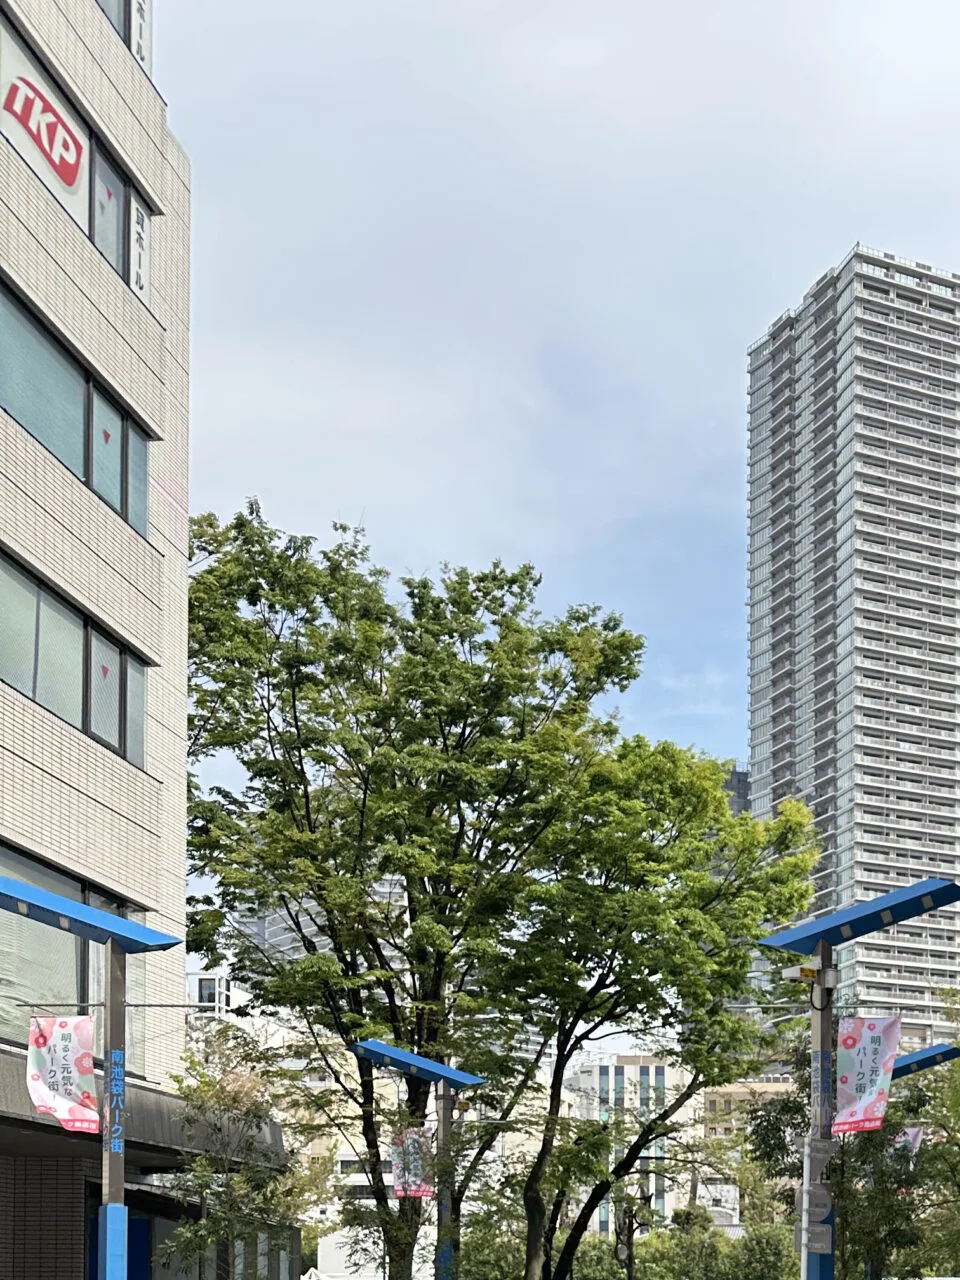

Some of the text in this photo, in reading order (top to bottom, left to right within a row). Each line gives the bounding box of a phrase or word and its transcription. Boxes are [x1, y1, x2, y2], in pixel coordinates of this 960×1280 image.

[11, 79, 77, 167] TKP
[60, 1032, 73, 1097] 明るく元気な
[111, 1049, 124, 1153] 南池袋パーク街
